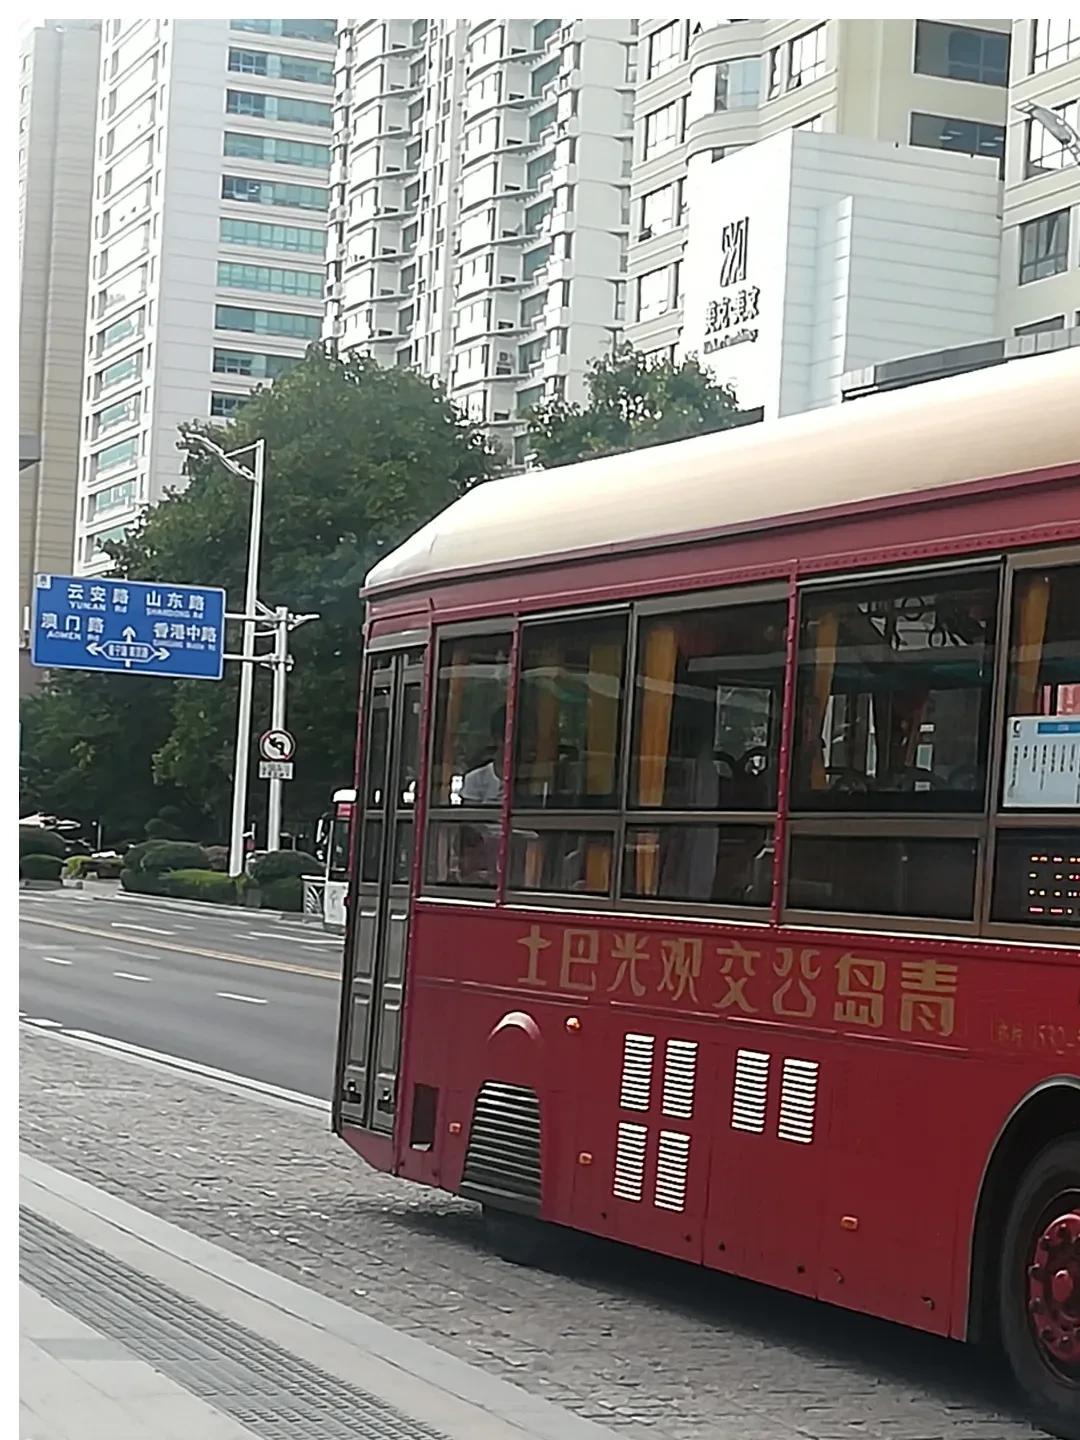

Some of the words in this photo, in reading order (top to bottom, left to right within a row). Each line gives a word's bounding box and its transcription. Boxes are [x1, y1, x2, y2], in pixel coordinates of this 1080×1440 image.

[68, 584, 128, 604] 云安路
[146, 590, 204, 611] 山东路
[41, 613, 104, 633] 澳门路
[153, 623, 217, 642] 香港中路
